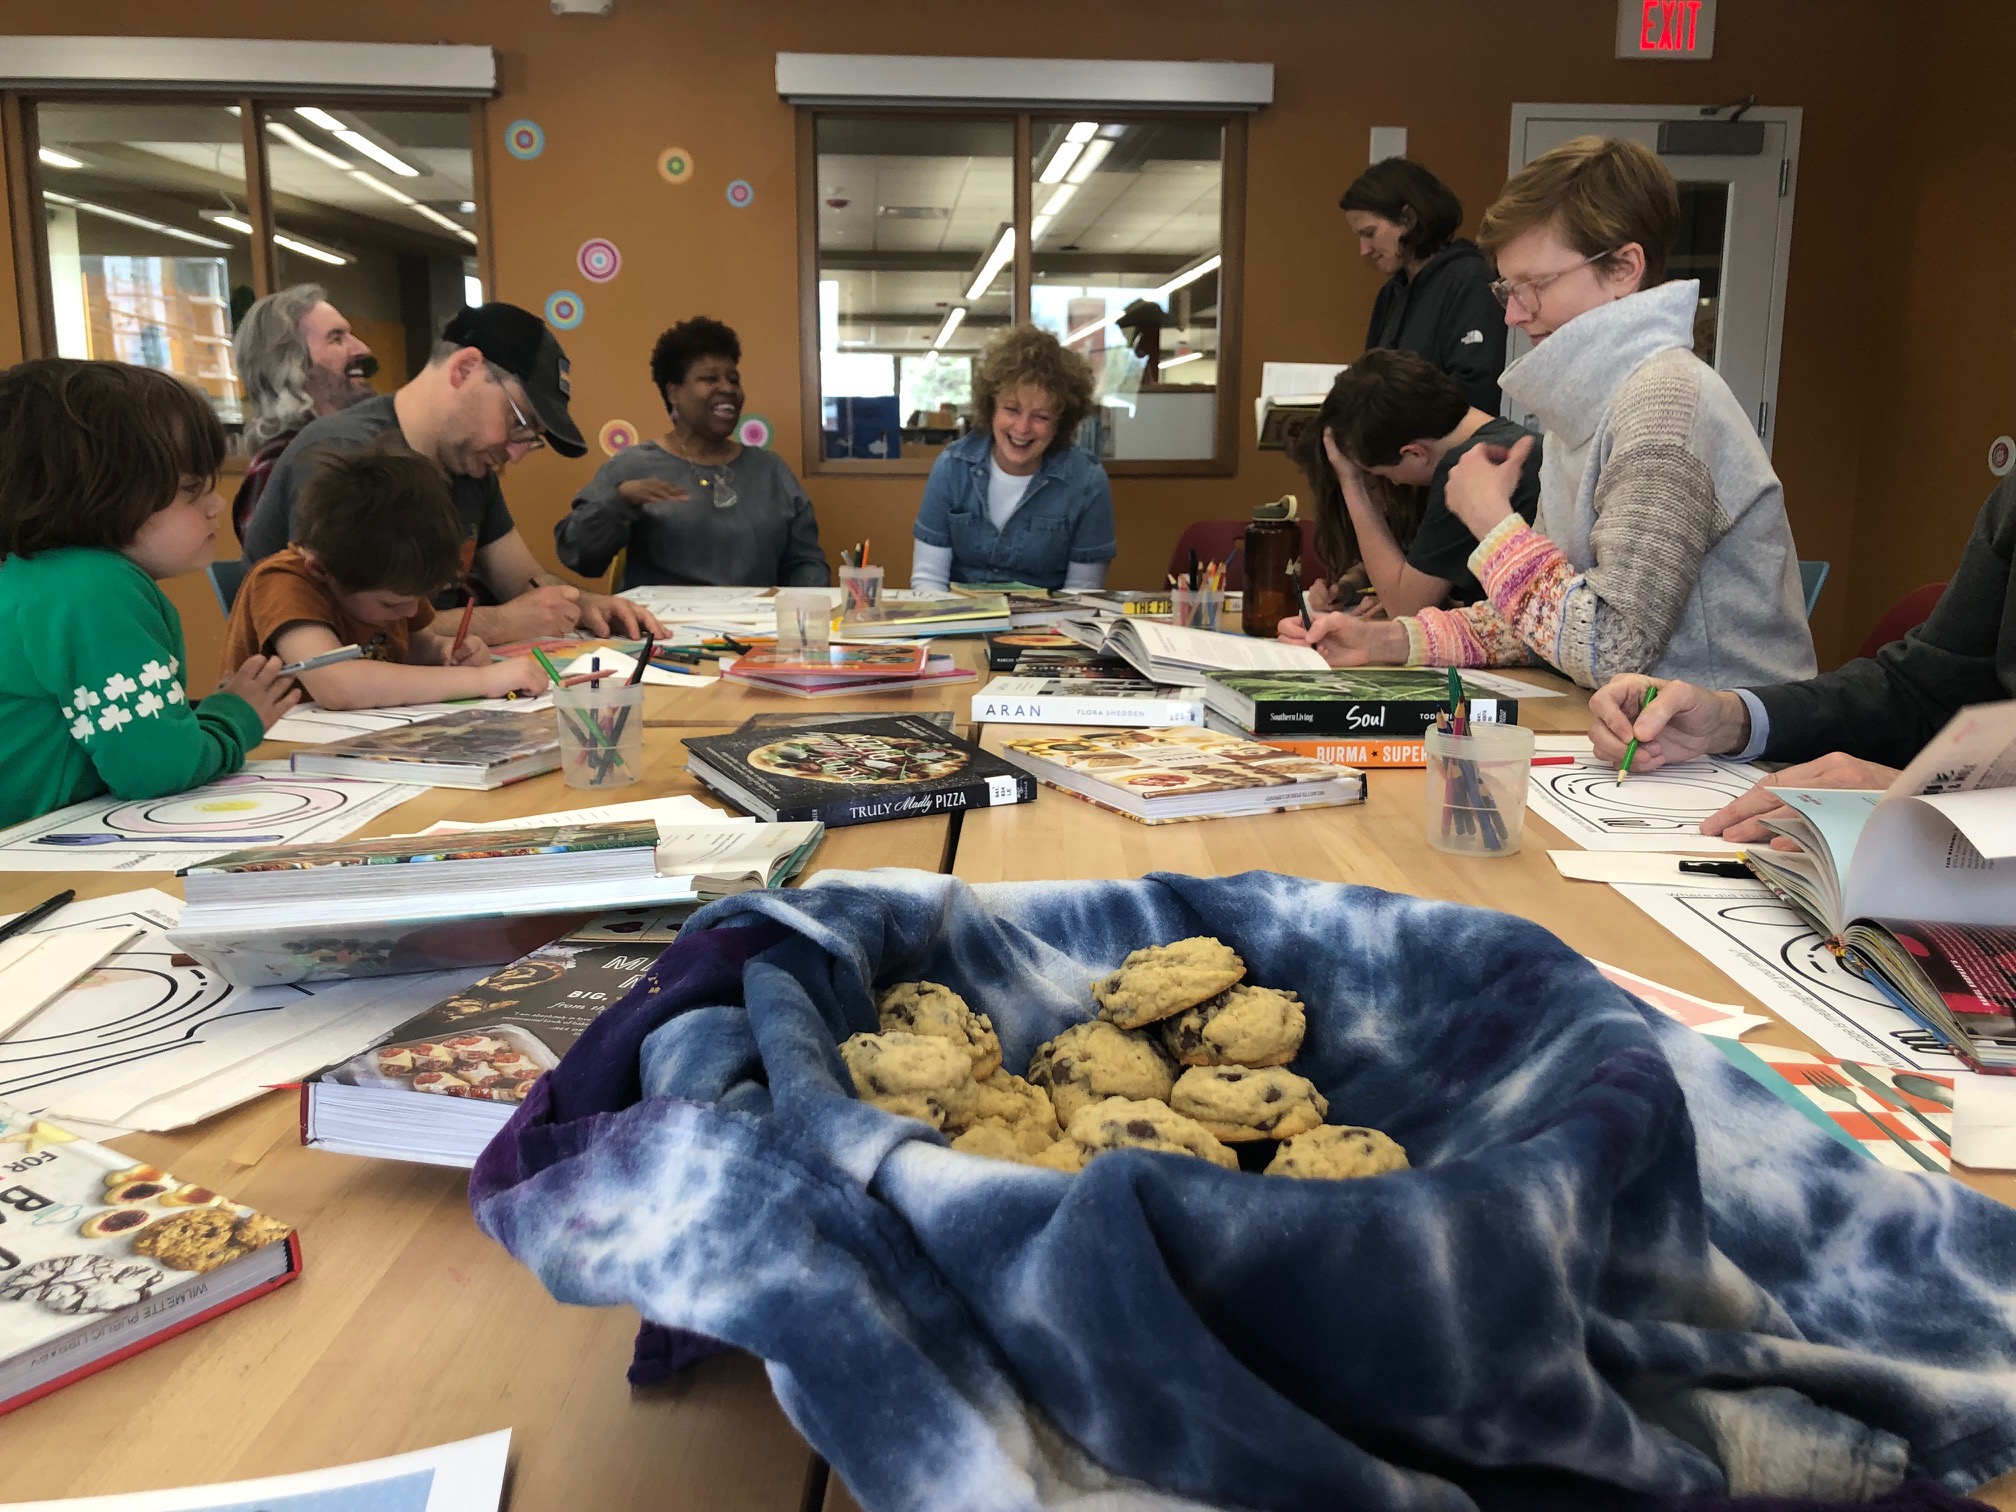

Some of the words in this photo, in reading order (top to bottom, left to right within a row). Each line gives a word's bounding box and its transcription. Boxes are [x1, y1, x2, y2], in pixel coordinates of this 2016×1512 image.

[1640, 0, 1702, 51] EXIT
[1134, 602, 1152, 614] THE
[986, 704, 1041, 717] ARAN
[1076, 708, 1104, 717] FLORA
[1106, 708, 1145, 718] SHEDDEN
[1270, 712, 1295, 722] Southern
[1296, 712, 1314, 723] Living
[1346, 705, 1386, 730] Soul
[1316, 746, 1367, 763] BURMA
[849, 803, 893, 819] TRULY
[894, 796, 933, 814] Madly
[936, 792, 966, 808] PIZZA
[567, 990, 608, 1001] BIG,
[546, 1002, 586, 1010] from
[4, 1150, 59, 1174] FOR
[144, 1282, 208, 1319] WILMETTE
